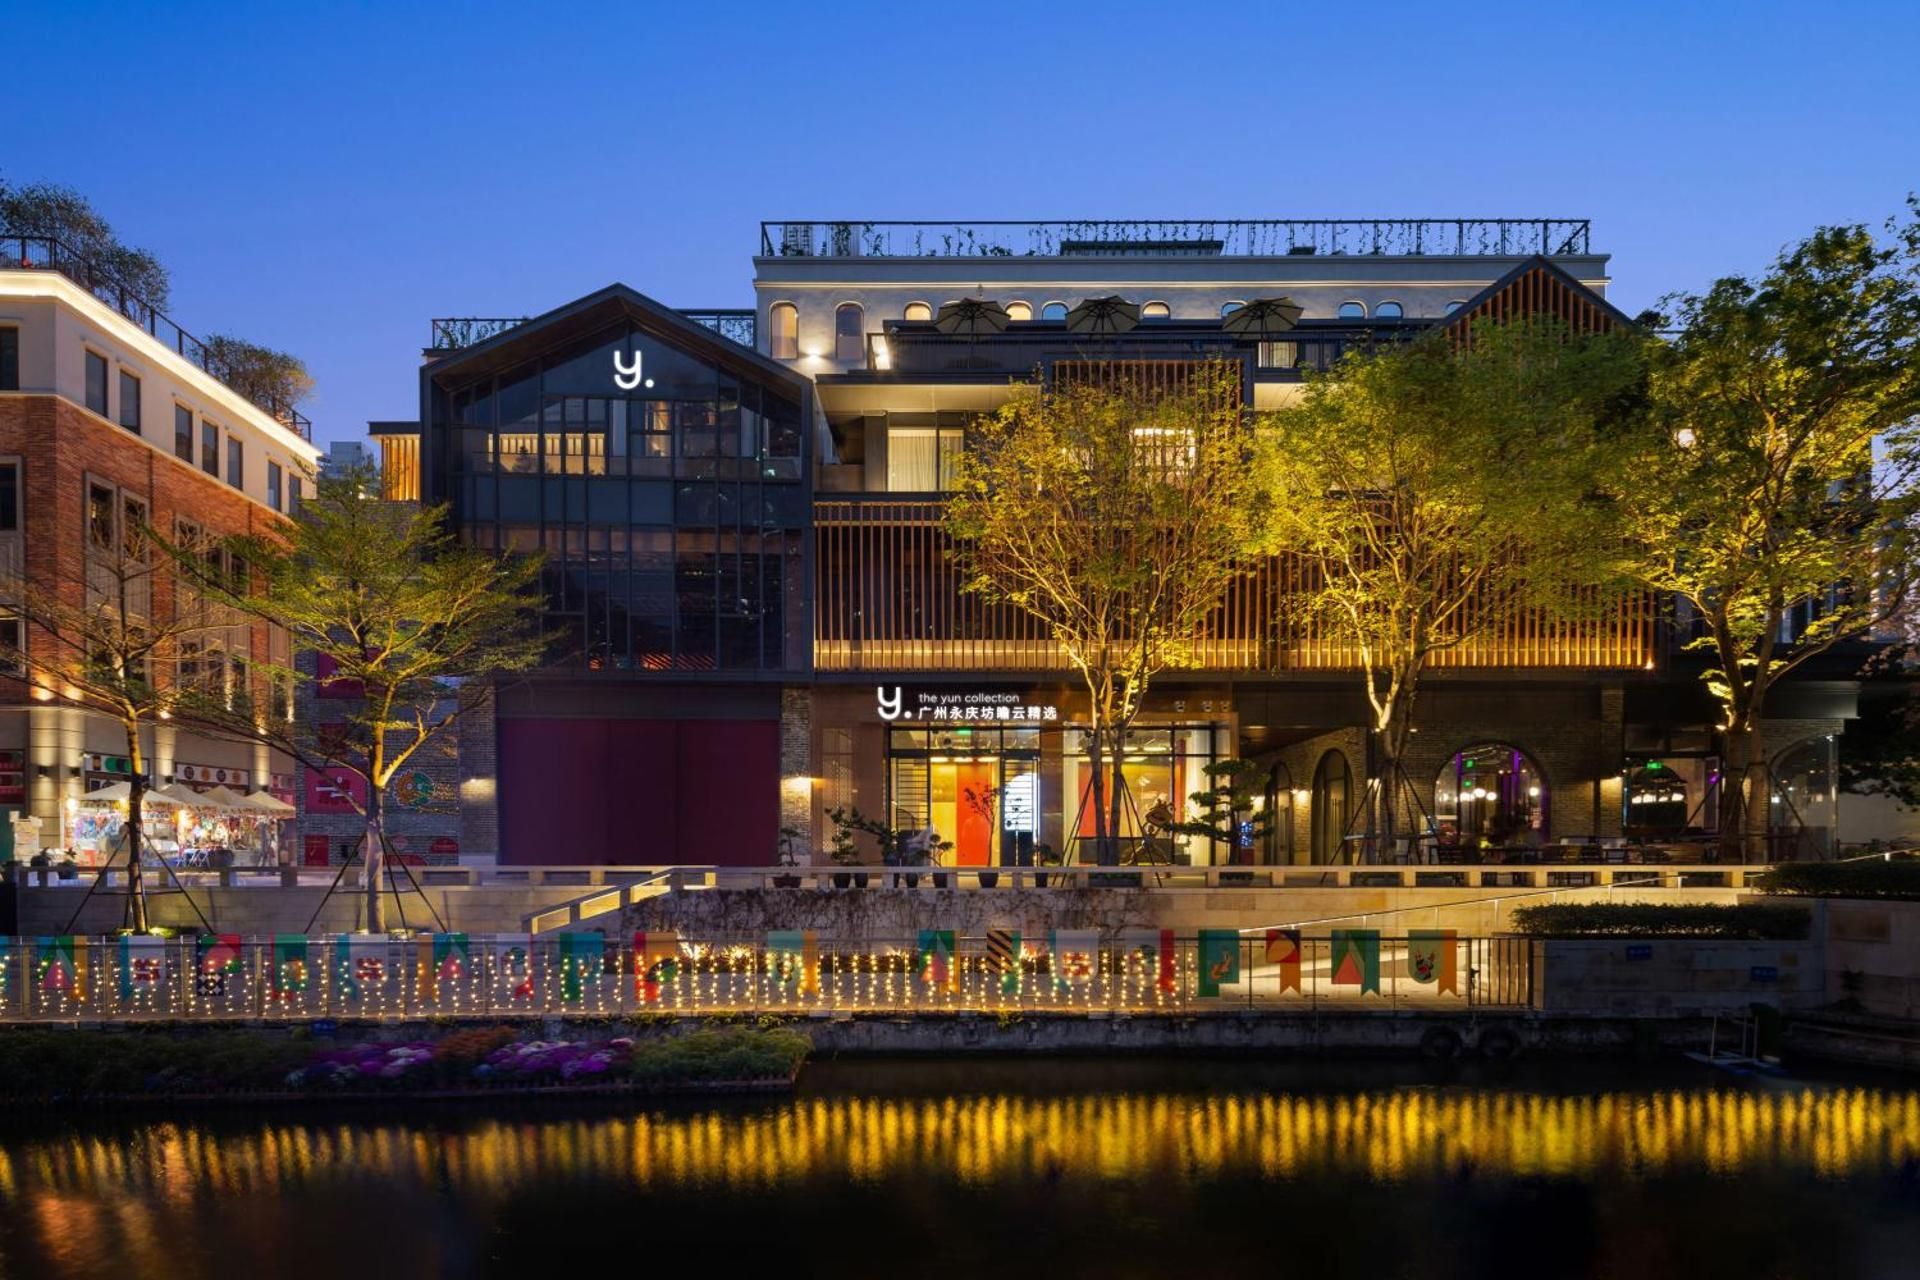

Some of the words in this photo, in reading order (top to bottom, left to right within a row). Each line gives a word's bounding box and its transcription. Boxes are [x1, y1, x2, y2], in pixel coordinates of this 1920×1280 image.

[918, 693, 938, 704] the
[940, 695, 961, 706] yun
[964, 693, 1020, 704] collection
[918, 706, 1057, 721] 广州永庆坊瞻云精选
